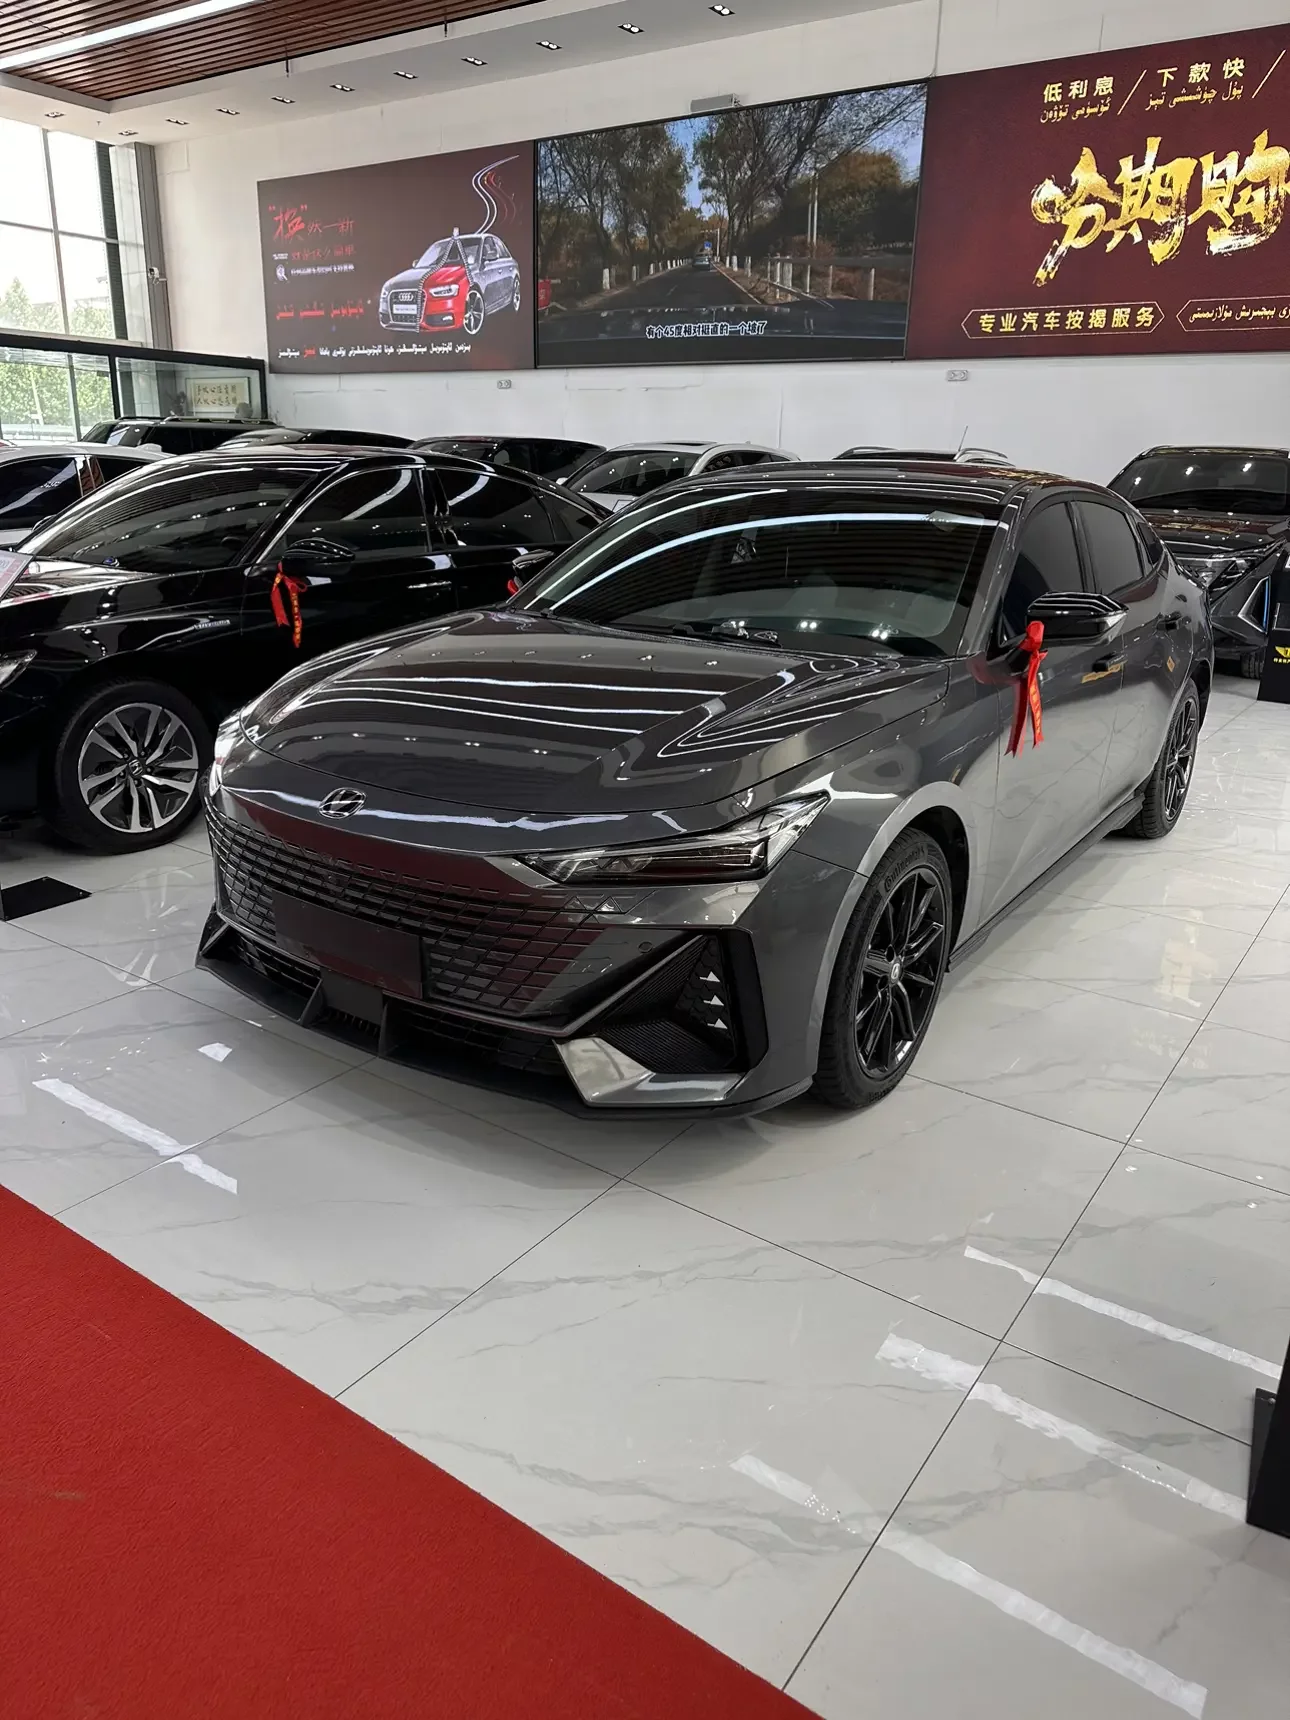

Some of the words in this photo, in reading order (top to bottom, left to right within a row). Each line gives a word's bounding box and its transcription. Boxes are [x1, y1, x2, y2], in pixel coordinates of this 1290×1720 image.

[1157, 57, 1245, 88] 下款快
[1043, 75, 1114, 103] 低利息
[1031, 128, 1290, 287] 分期购
[979, 306, 1155, 333] 专业汽车按揭服务
